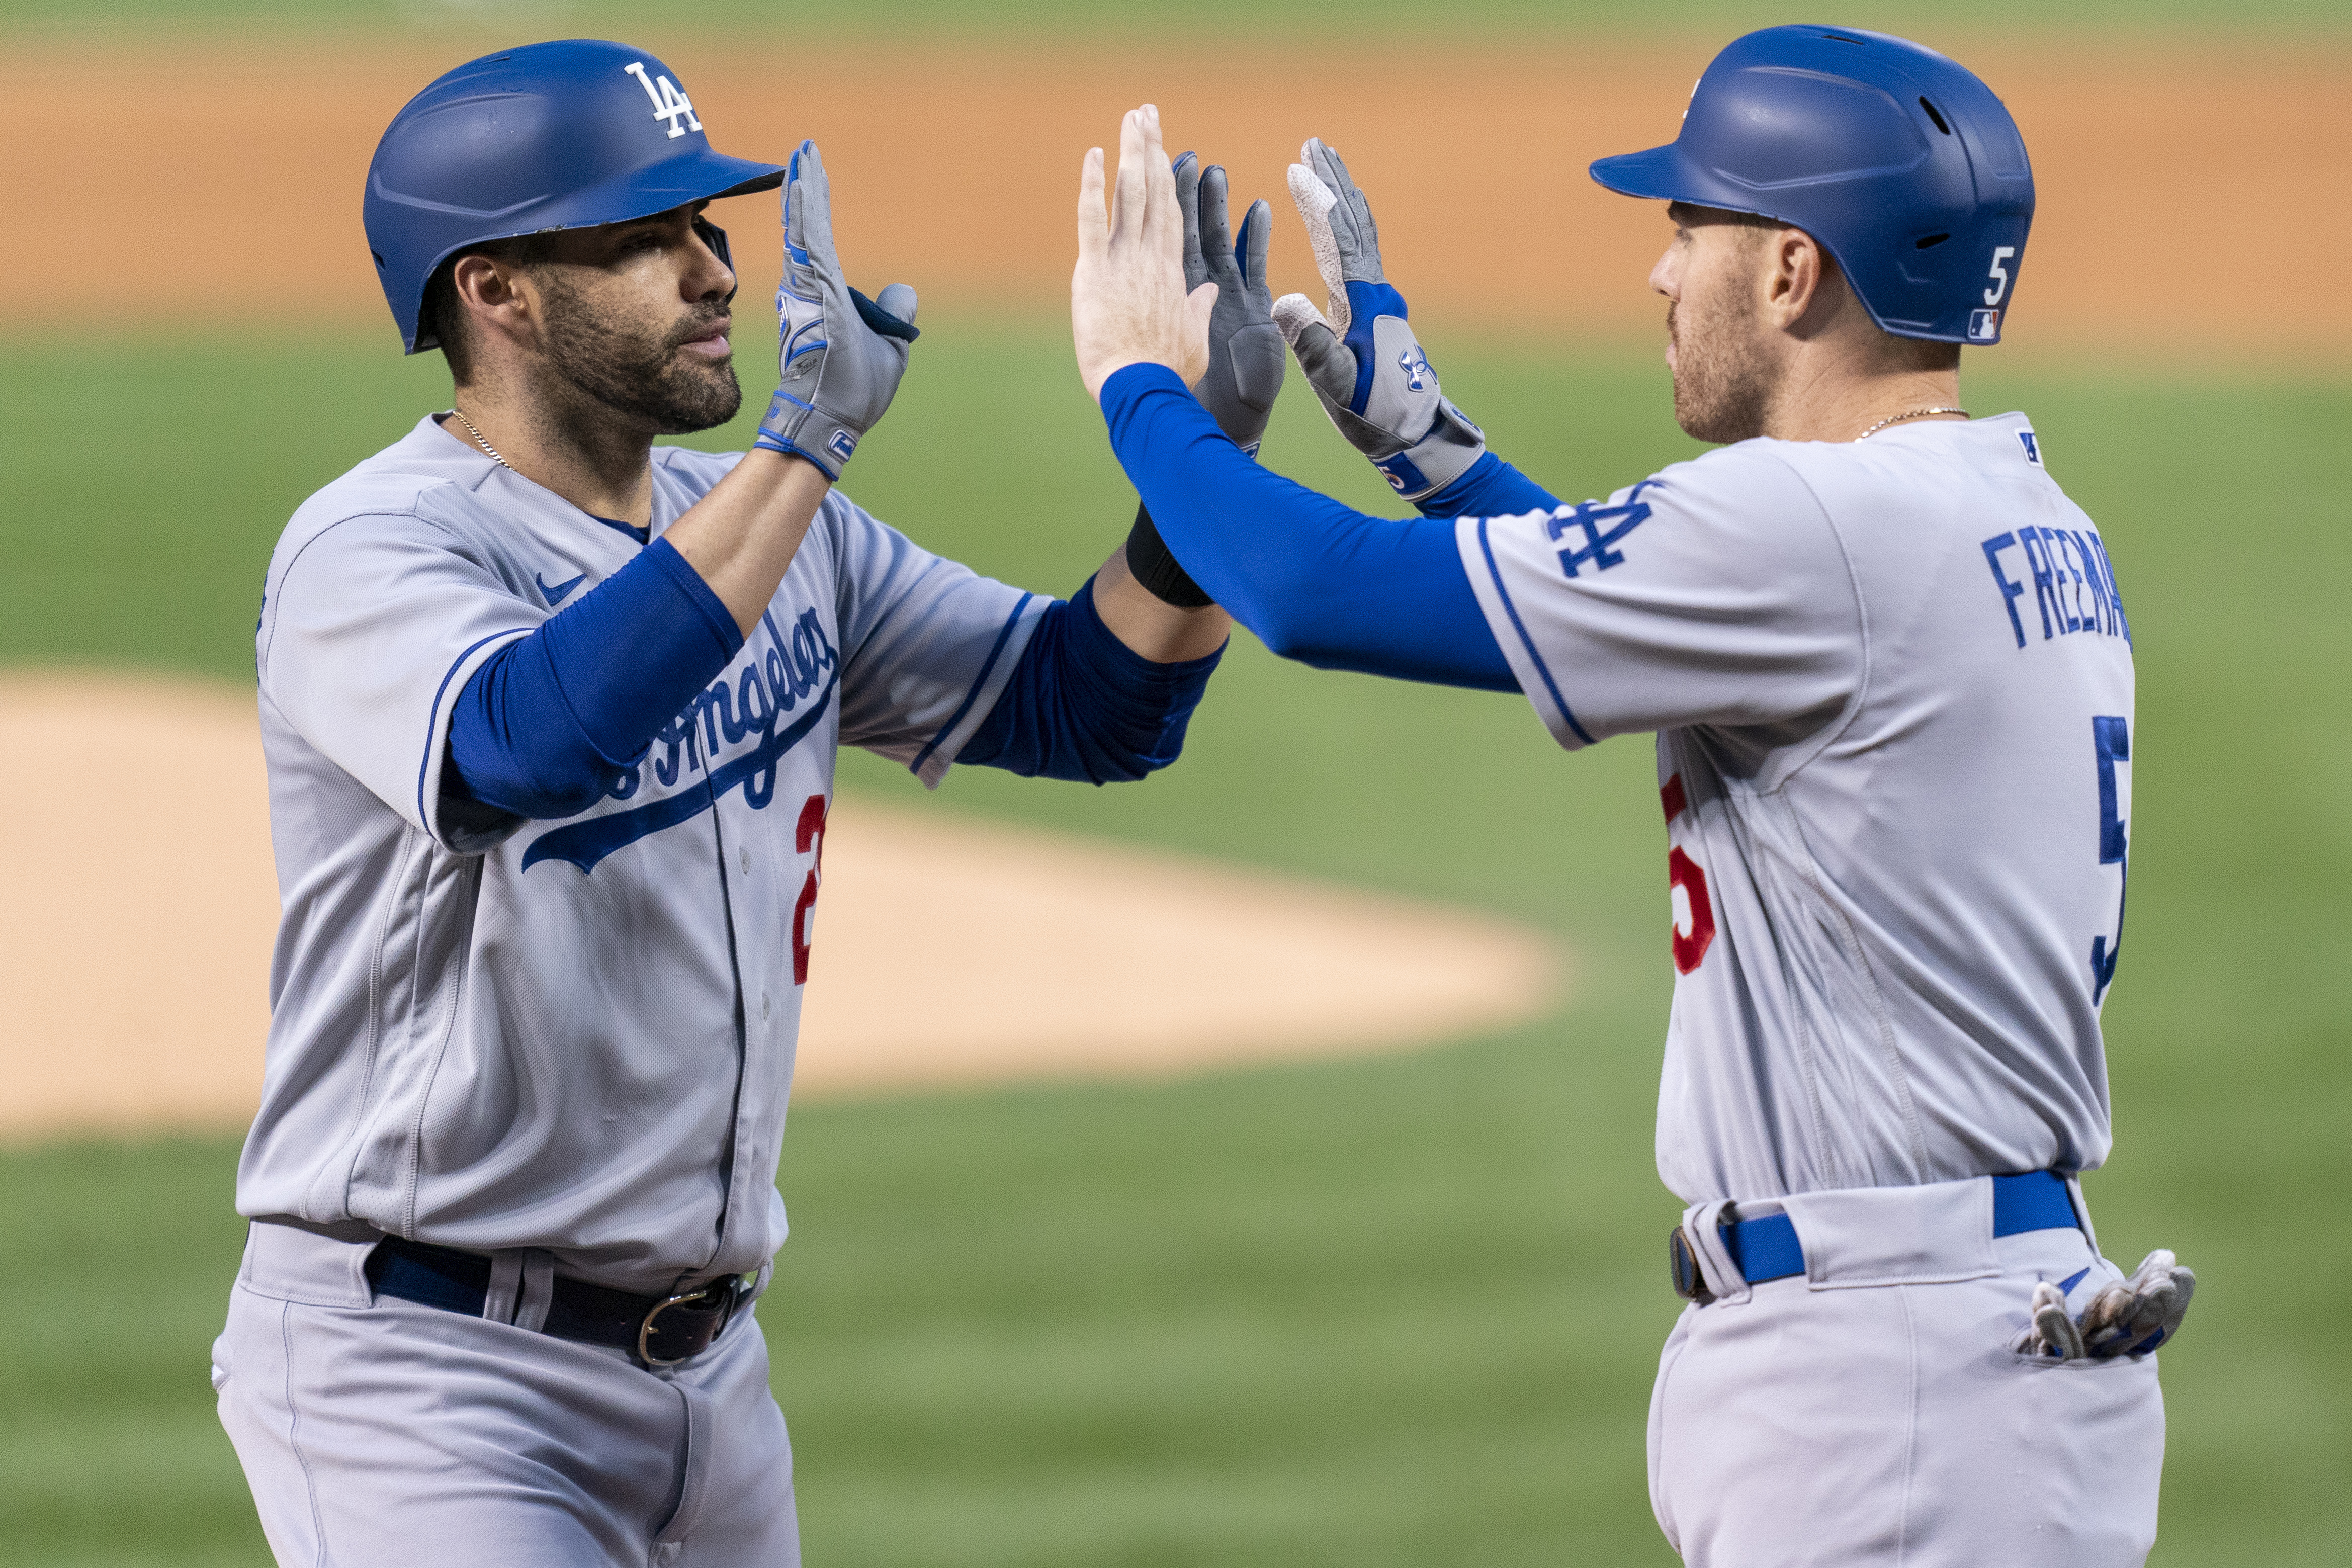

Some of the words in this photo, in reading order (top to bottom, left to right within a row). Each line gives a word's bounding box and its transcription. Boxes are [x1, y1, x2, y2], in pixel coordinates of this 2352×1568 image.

[624, 61, 703, 140] LA
[1983, 246, 2015, 306] 5
[1377, 466, 1405, 490] 5
[1547, 479, 1666, 578] LA
[1981, 525, 2134, 655] FREEMA
[655, 606, 839, 810] Angeles
[2090, 716, 2130, 1007] 5
